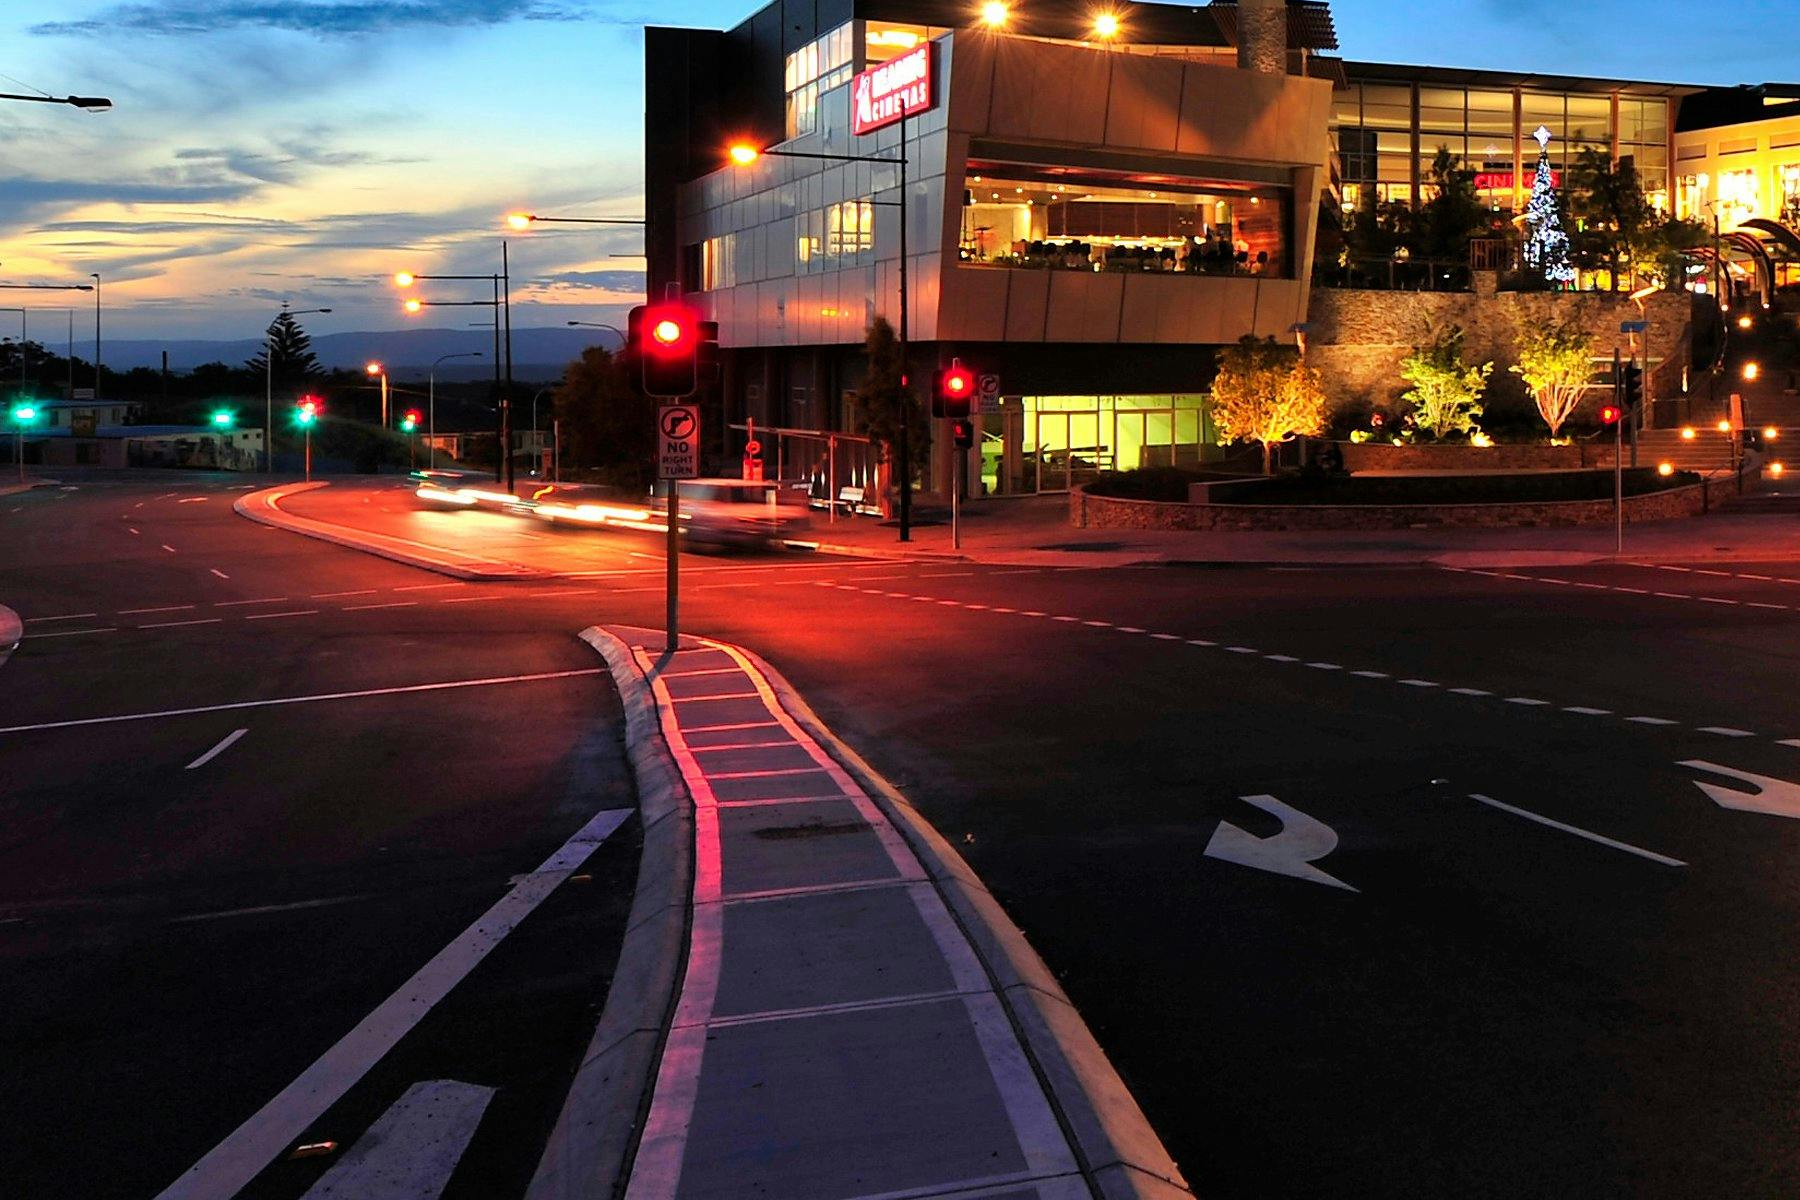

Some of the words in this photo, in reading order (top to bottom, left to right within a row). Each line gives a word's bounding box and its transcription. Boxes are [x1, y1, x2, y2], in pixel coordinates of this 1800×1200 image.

[667, 441, 689, 453] NO
[662, 455, 693, 464] RIGHT
[664, 466, 693, 475] TURN
